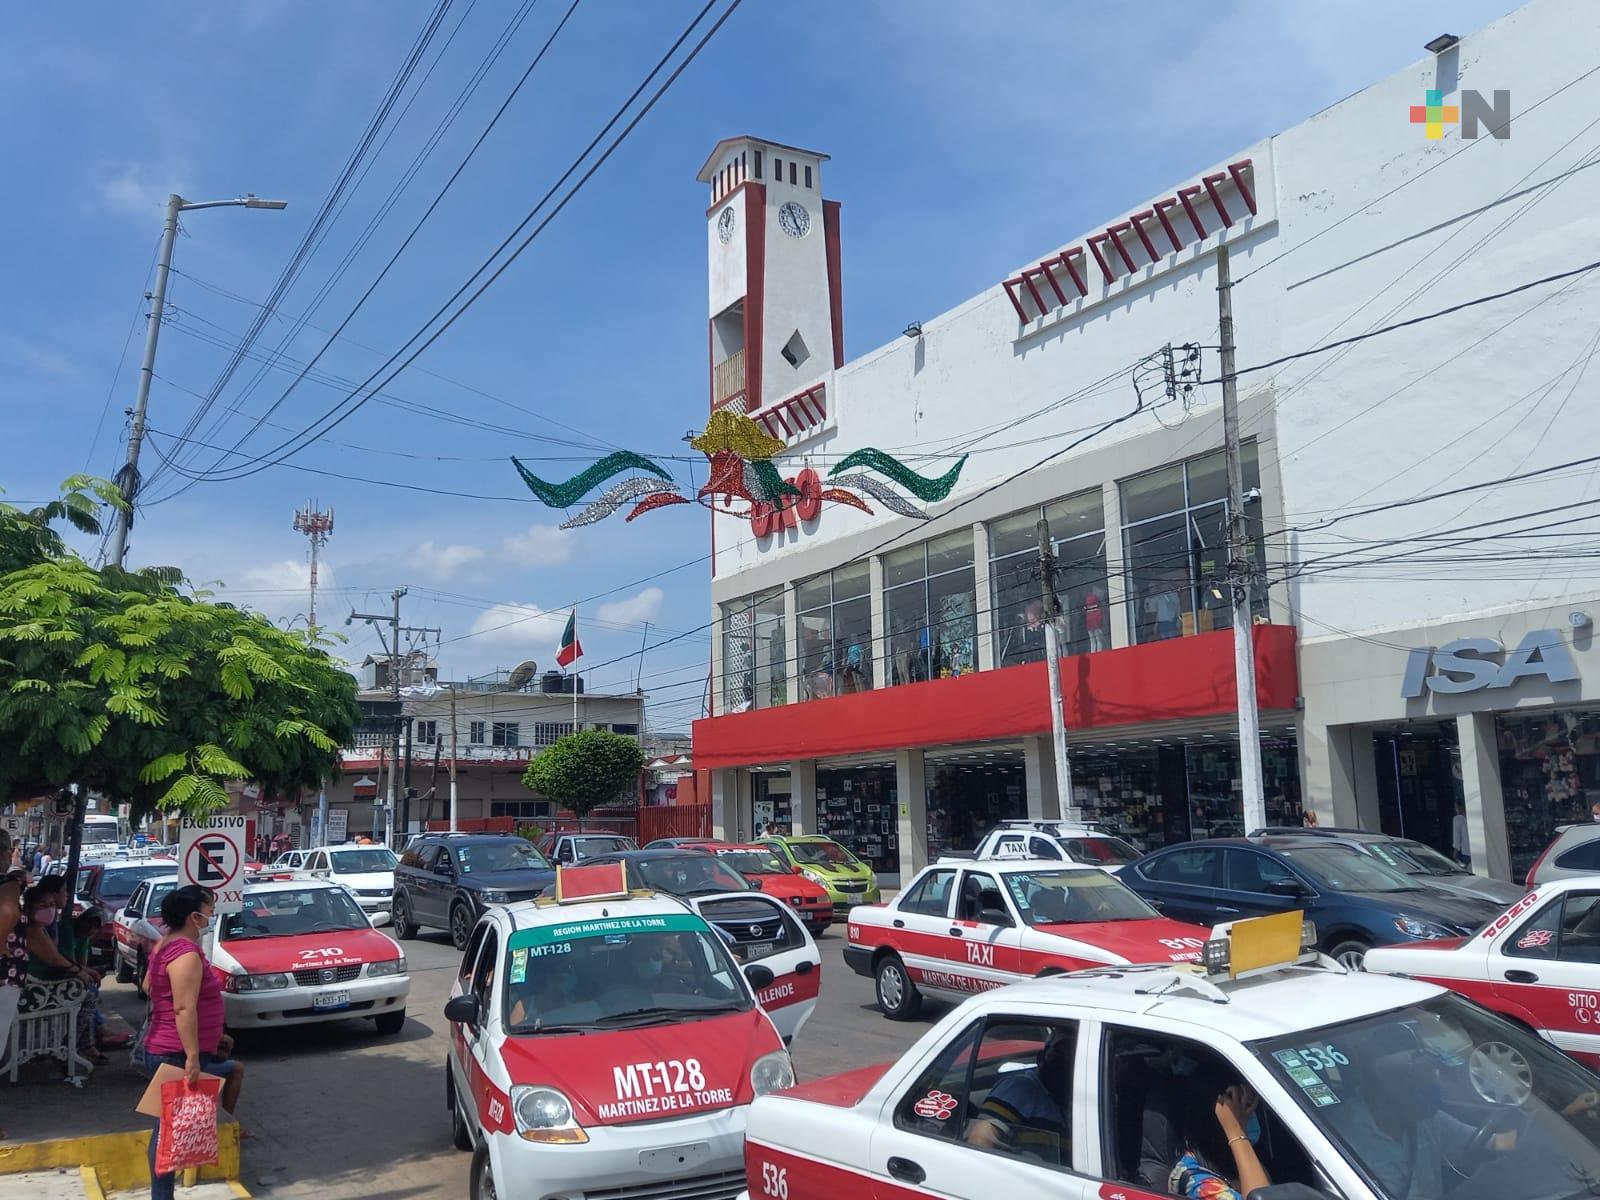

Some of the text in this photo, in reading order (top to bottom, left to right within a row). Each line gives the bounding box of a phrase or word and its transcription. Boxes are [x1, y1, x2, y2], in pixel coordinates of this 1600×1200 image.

[1400, 628, 1582, 698] ISA
[1005, 843, 1028, 854] TAXI
[553, 918, 666, 937] REGION MARTINEZ DE LA TORRE
[298, 947, 344, 959] 210
[530, 943, 572, 958] MT-128
[965, 942, 994, 966] TAXI
[1158, 937, 1204, 950] 810
[758, 983, 794, 1004] LLENDE
[1568, 992, 1597, 1009] SITIO
[1299, 1045, 1349, 1070] 536
[613, 1058, 706, 1100] MT-128
[598, 1088, 733, 1119] MARTINEZ DE LA TORRE
[763, 1161, 788, 1200] 536
